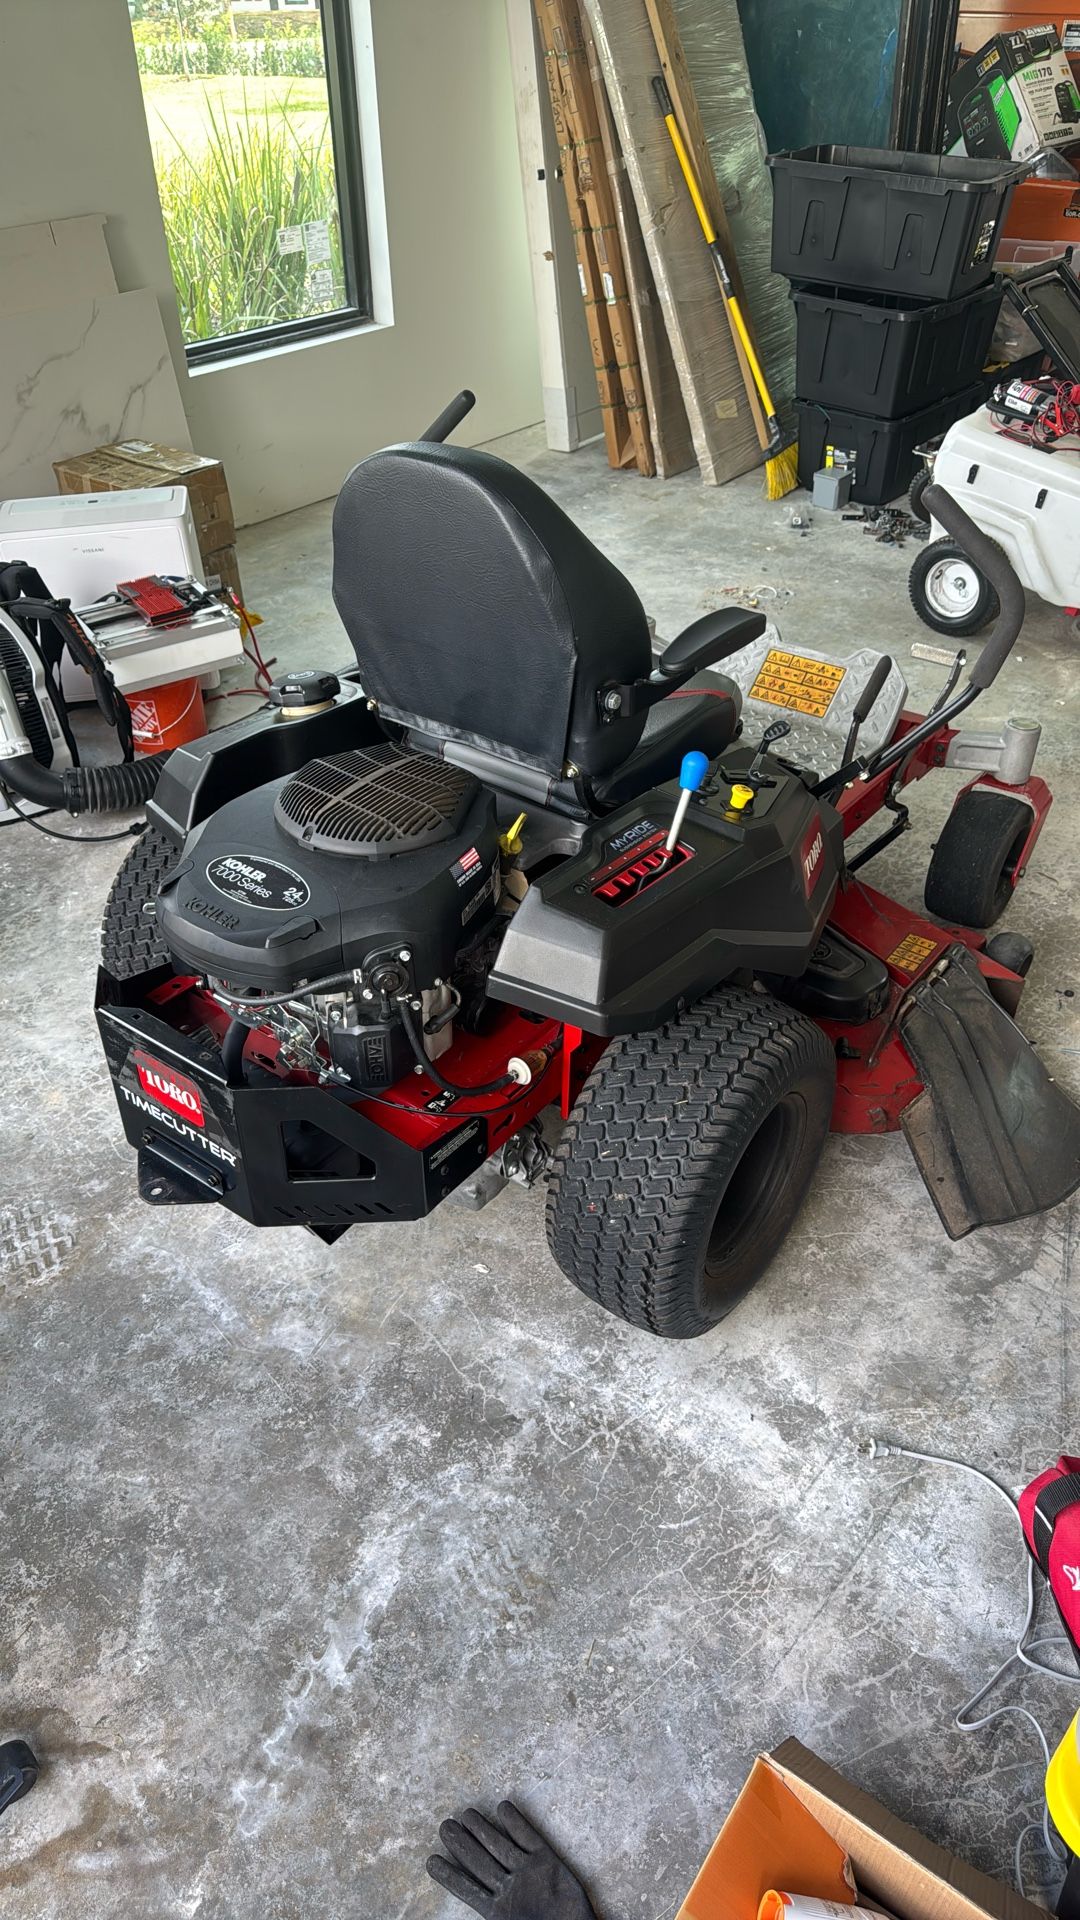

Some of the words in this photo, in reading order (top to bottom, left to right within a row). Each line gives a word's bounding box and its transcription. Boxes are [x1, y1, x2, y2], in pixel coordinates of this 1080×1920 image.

[222, 857, 267, 882] KOHLER
[804, 832, 823, 880] TORO
[211, 864, 241, 882] 7000
[237, 877, 272, 898] Series
[185, 897, 240, 930] KOHLER
[141, 1067, 201, 1114] TORO
[120, 1086, 237, 1167] TIMECUTTER
